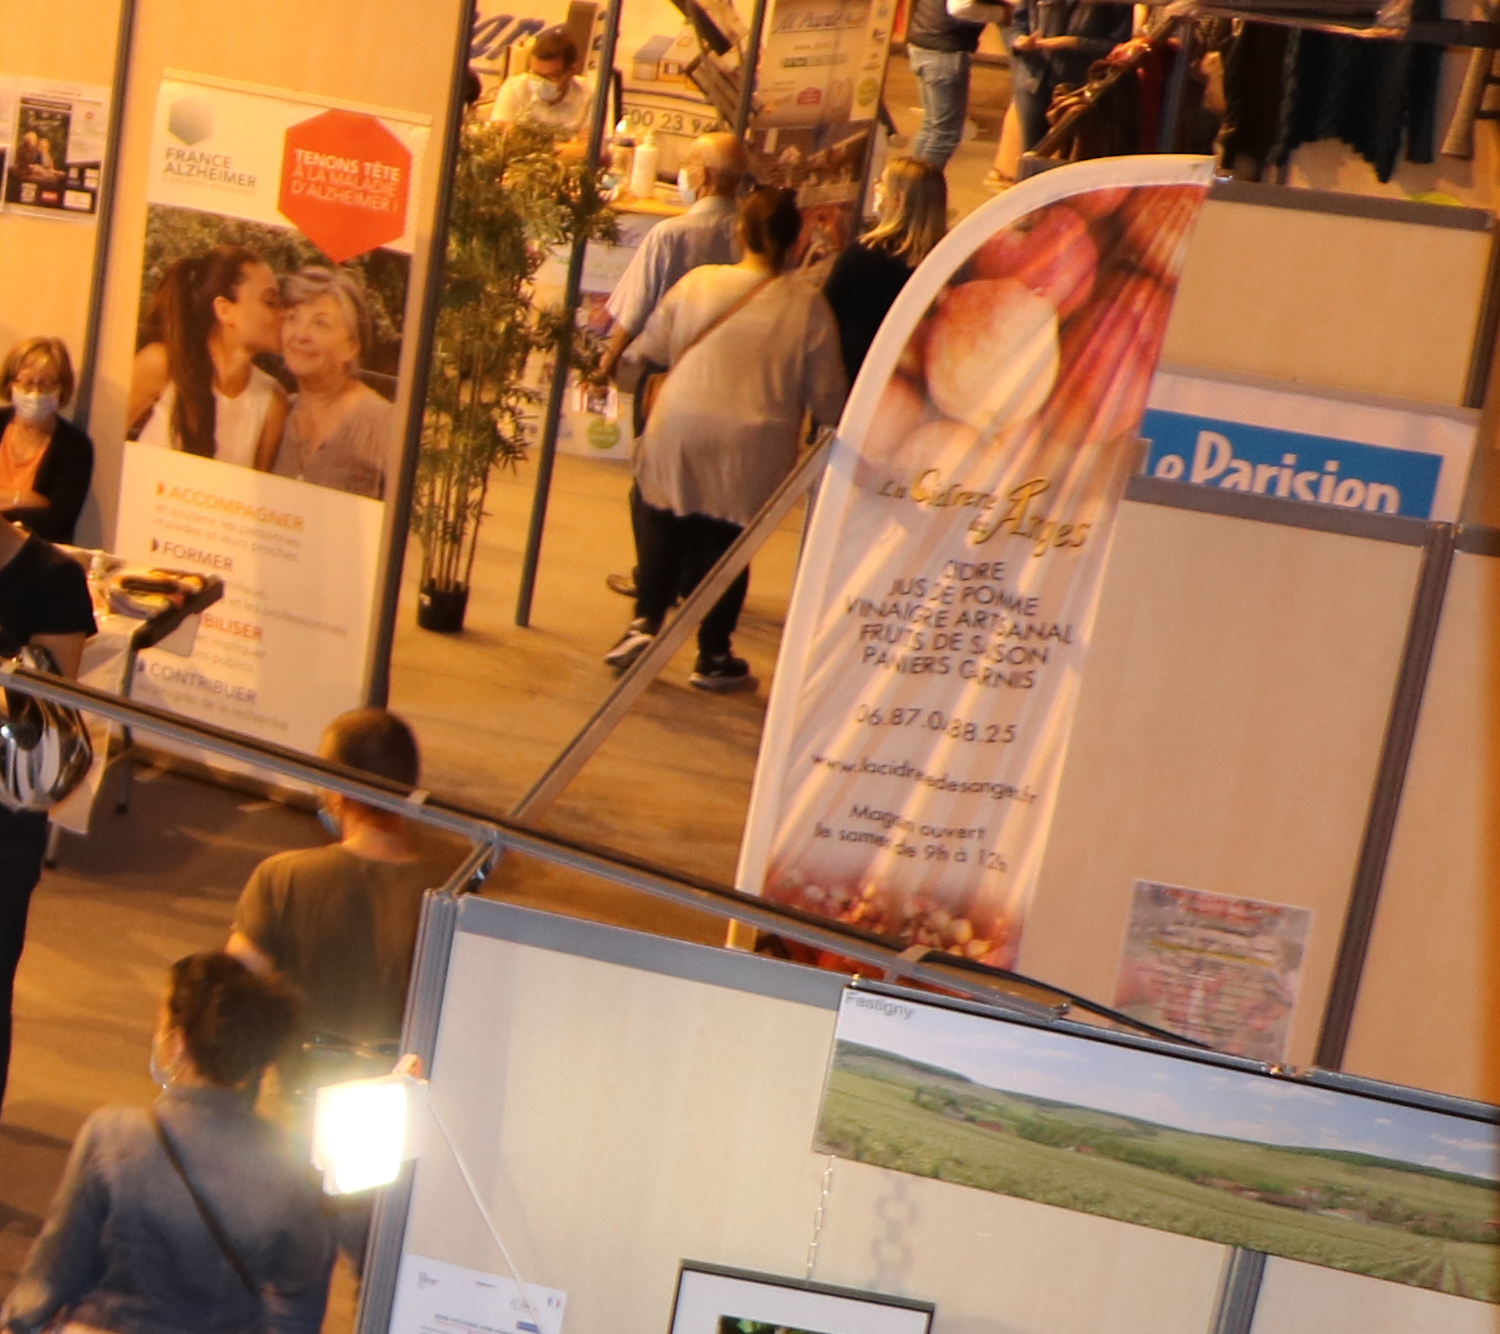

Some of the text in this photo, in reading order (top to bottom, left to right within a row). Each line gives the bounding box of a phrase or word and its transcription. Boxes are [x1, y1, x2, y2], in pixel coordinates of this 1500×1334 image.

[165, 147, 233, 169] FRANCE
[294, 148, 401, 182] TENONS TÊTE
[164, 161, 258, 189] ALZHEIMER
[306, 169, 327, 182] LA
[330, 172, 398, 196] MALADIE
[290, 181, 391, 211] D'ALZHEIMER
[169, 485, 305, 531] ACCOMPAGNER
[162, 540, 235, 573] FORMER
[931, 632, 963, 652] DE
[150, 660, 258, 705] CONTRIBUER
[843, 992, 915, 1021] Festigny
